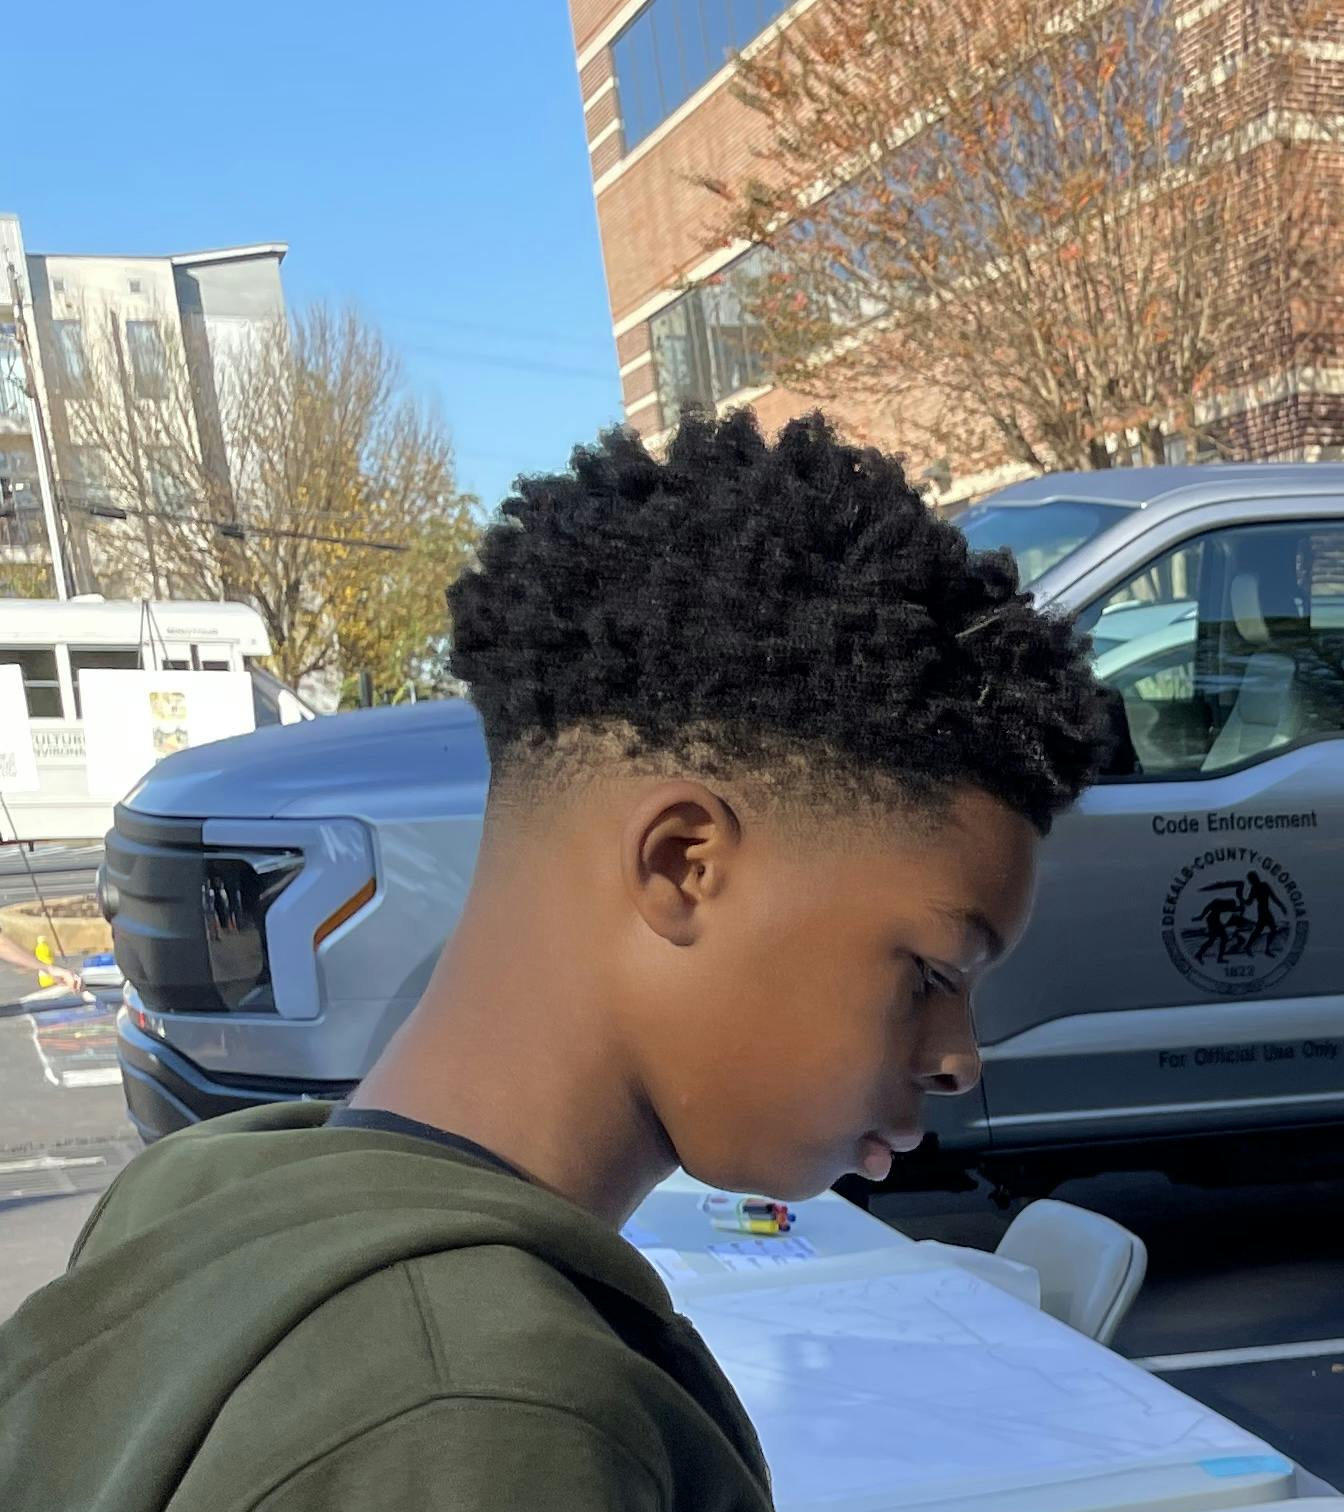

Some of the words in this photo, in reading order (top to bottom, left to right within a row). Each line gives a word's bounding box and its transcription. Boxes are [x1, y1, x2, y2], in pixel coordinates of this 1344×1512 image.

[1152, 812, 1199, 835] Code
[1207, 810, 1318, 832] Enforcement
[1162, 866, 1194, 926] DEKALB
[1193, 848, 1258, 870] COUNTY
[1261, 857, 1307, 919] GEORGIA
[1159, 1049, 1187, 1069] For
[1195, 1045, 1257, 1066] Official
[1264, 1044, 1295, 1062] Use
[1303, 1041, 1339, 1060] Only
